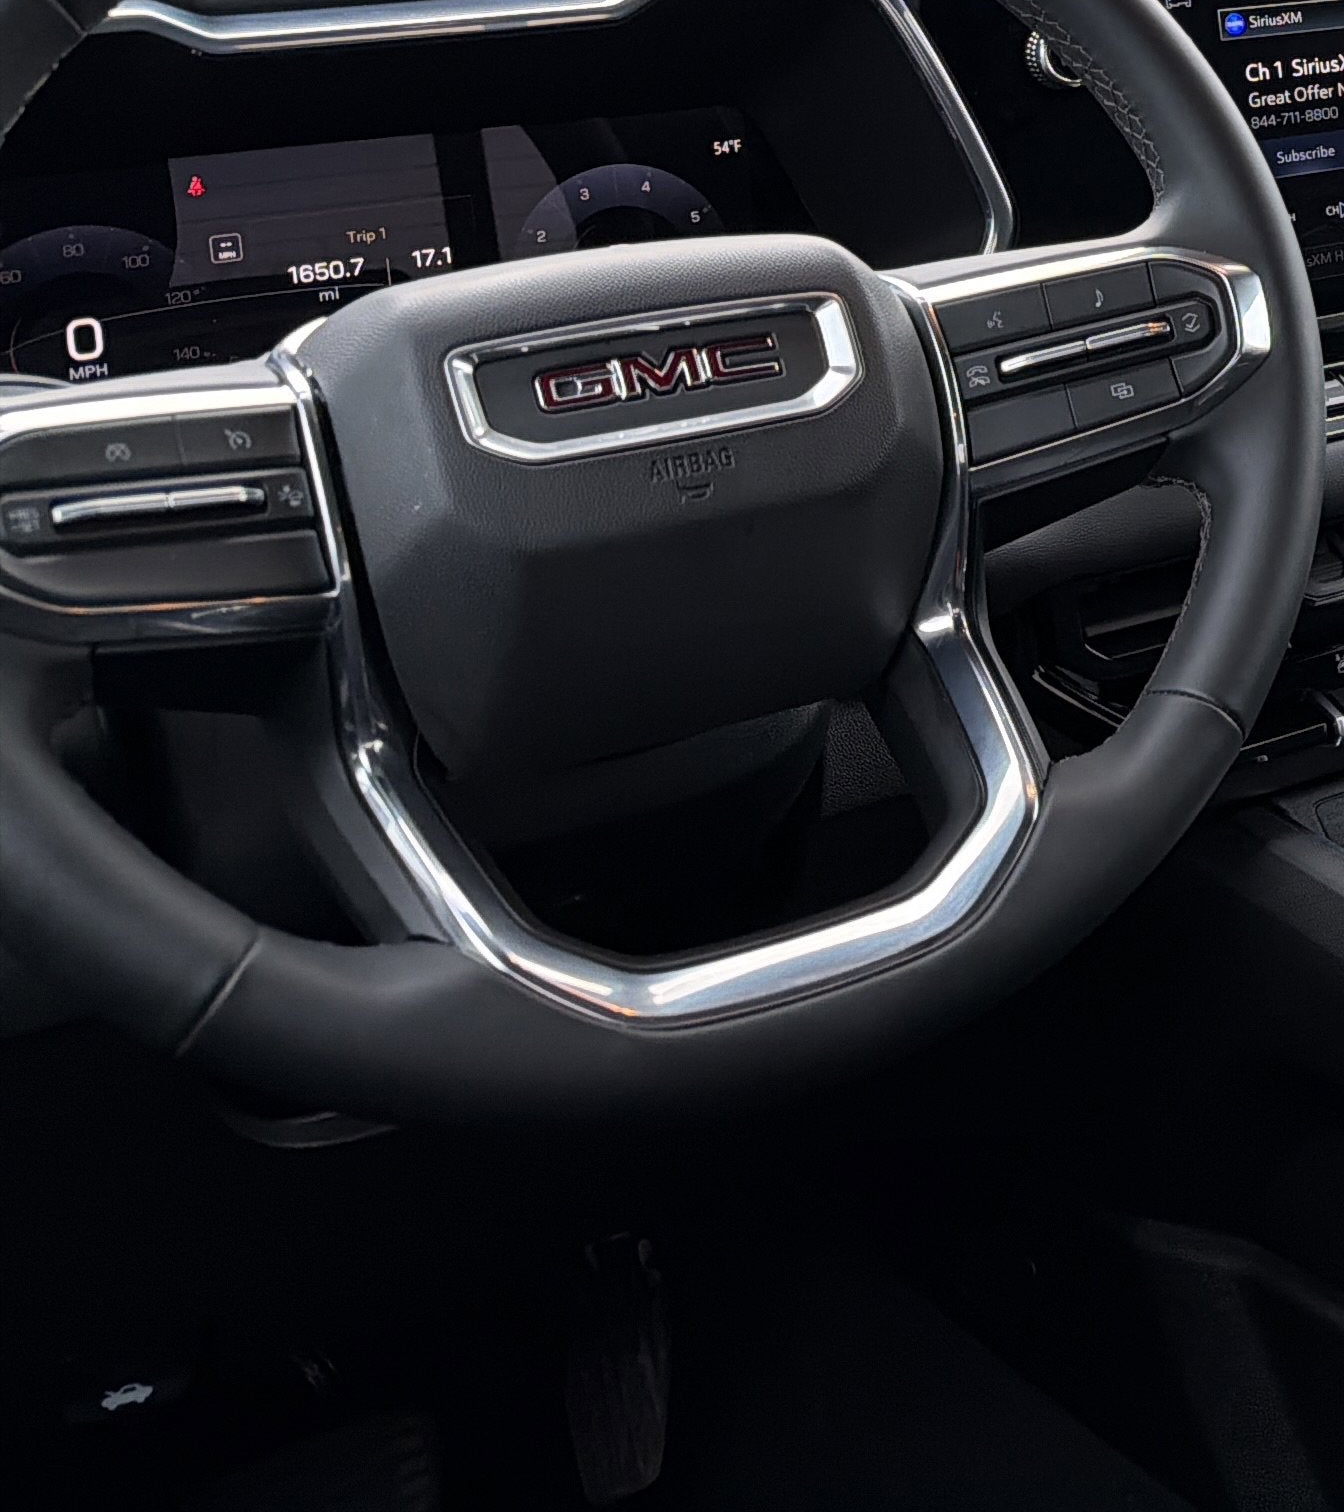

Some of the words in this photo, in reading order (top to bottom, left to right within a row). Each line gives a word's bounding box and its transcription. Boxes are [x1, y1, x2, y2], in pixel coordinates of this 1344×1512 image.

[1248, 11, 1303, 29] SiriusXM
[1244, 62, 1271, 82] Ch
[1273, 60, 1284, 79] 1
[1248, 90, 1292, 108] Great
[1293, 85, 1334, 102] Offer
[1250, 106, 1339, 129] 844-711-8800
[713, 139, 742, 156] 54°F
[1276, 145, 1336, 165] Subscribe
[580, 188, 590, 201] 3
[641, 181, 651, 193] 4
[690, 210, 701, 223] 5
[1325, 205, 1341, 217] CH
[345, 230, 376, 245] Trip
[379, 227, 386, 240] 1
[536, 230, 547, 244] 2
[62, 243, 84, 258] 80
[1306, 251, 1332, 267] sXM
[121, 254, 149, 269] 100
[287, 257, 364, 285] 1650.7
[411, 247, 453, 269] 17.1
[164, 290, 192, 306] 120
[318, 287, 340, 303] mi
[66, 317, 104, 361] 0
[172, 346, 201, 361] 140
[69, 363, 109, 381] MPH
[533, 332, 786, 414] GMC
[650, 448, 737, 484] AIRBAG
